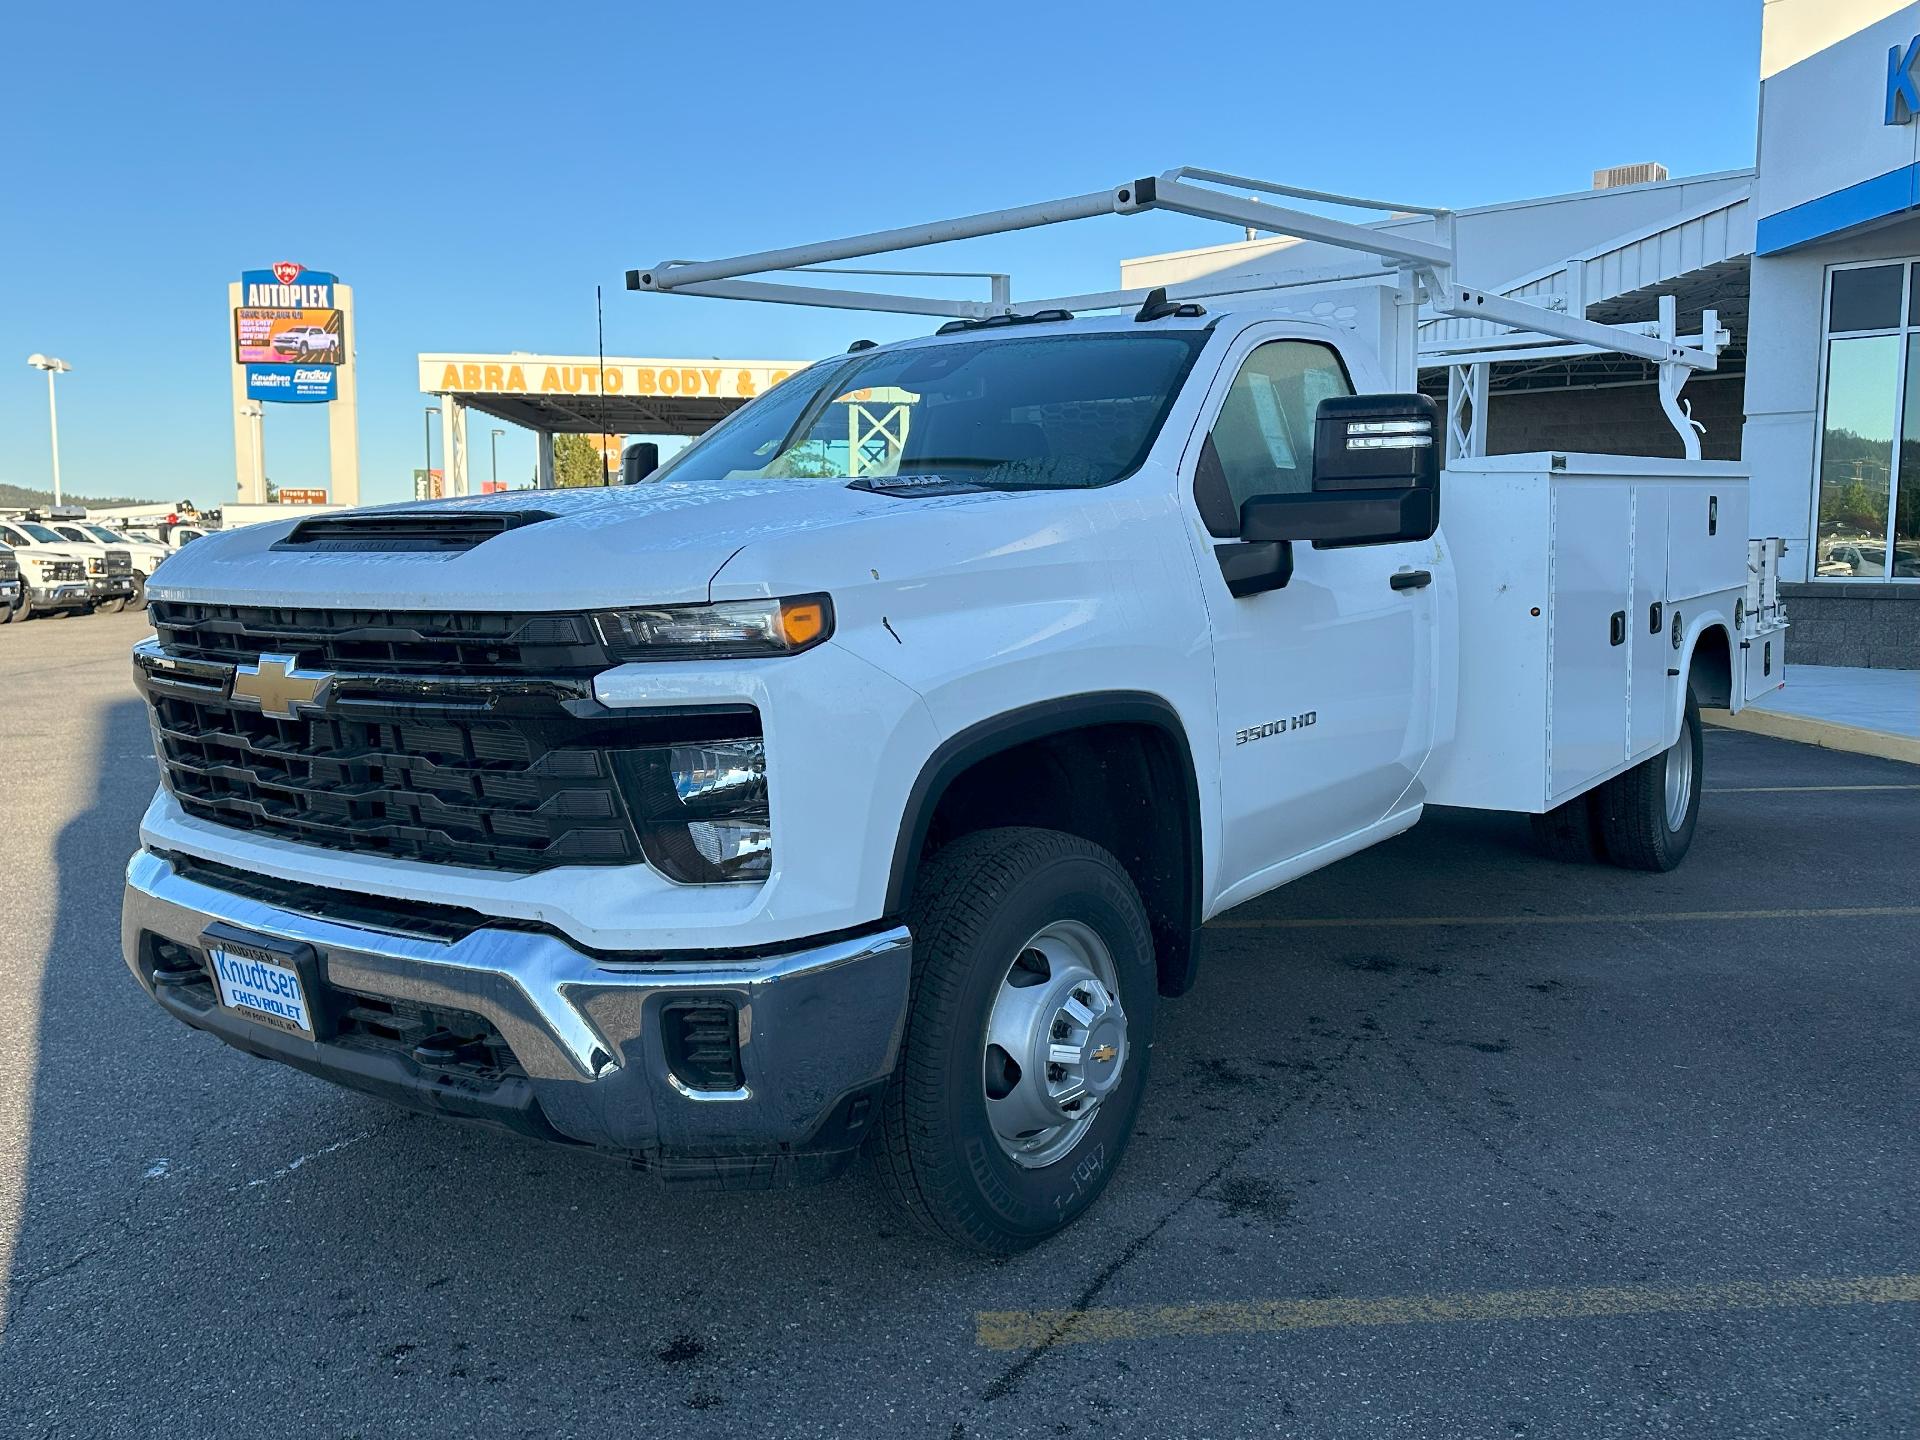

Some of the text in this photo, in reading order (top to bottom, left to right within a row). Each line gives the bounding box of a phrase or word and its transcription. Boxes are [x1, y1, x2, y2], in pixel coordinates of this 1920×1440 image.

[248, 284, 329, 308] AUTOPLEX
[293, 369, 331, 383] Findlay
[441, 364, 527, 391] ABRA
[541, 366, 623, 393] AUTO
[638, 368, 721, 395] BODY
[736, 370, 757, 396] &
[1236, 711, 1317, 746] 3500 HD
[215, 950, 301, 1000] Knudtsen
[232, 989, 301, 1020] CHEVROLET
